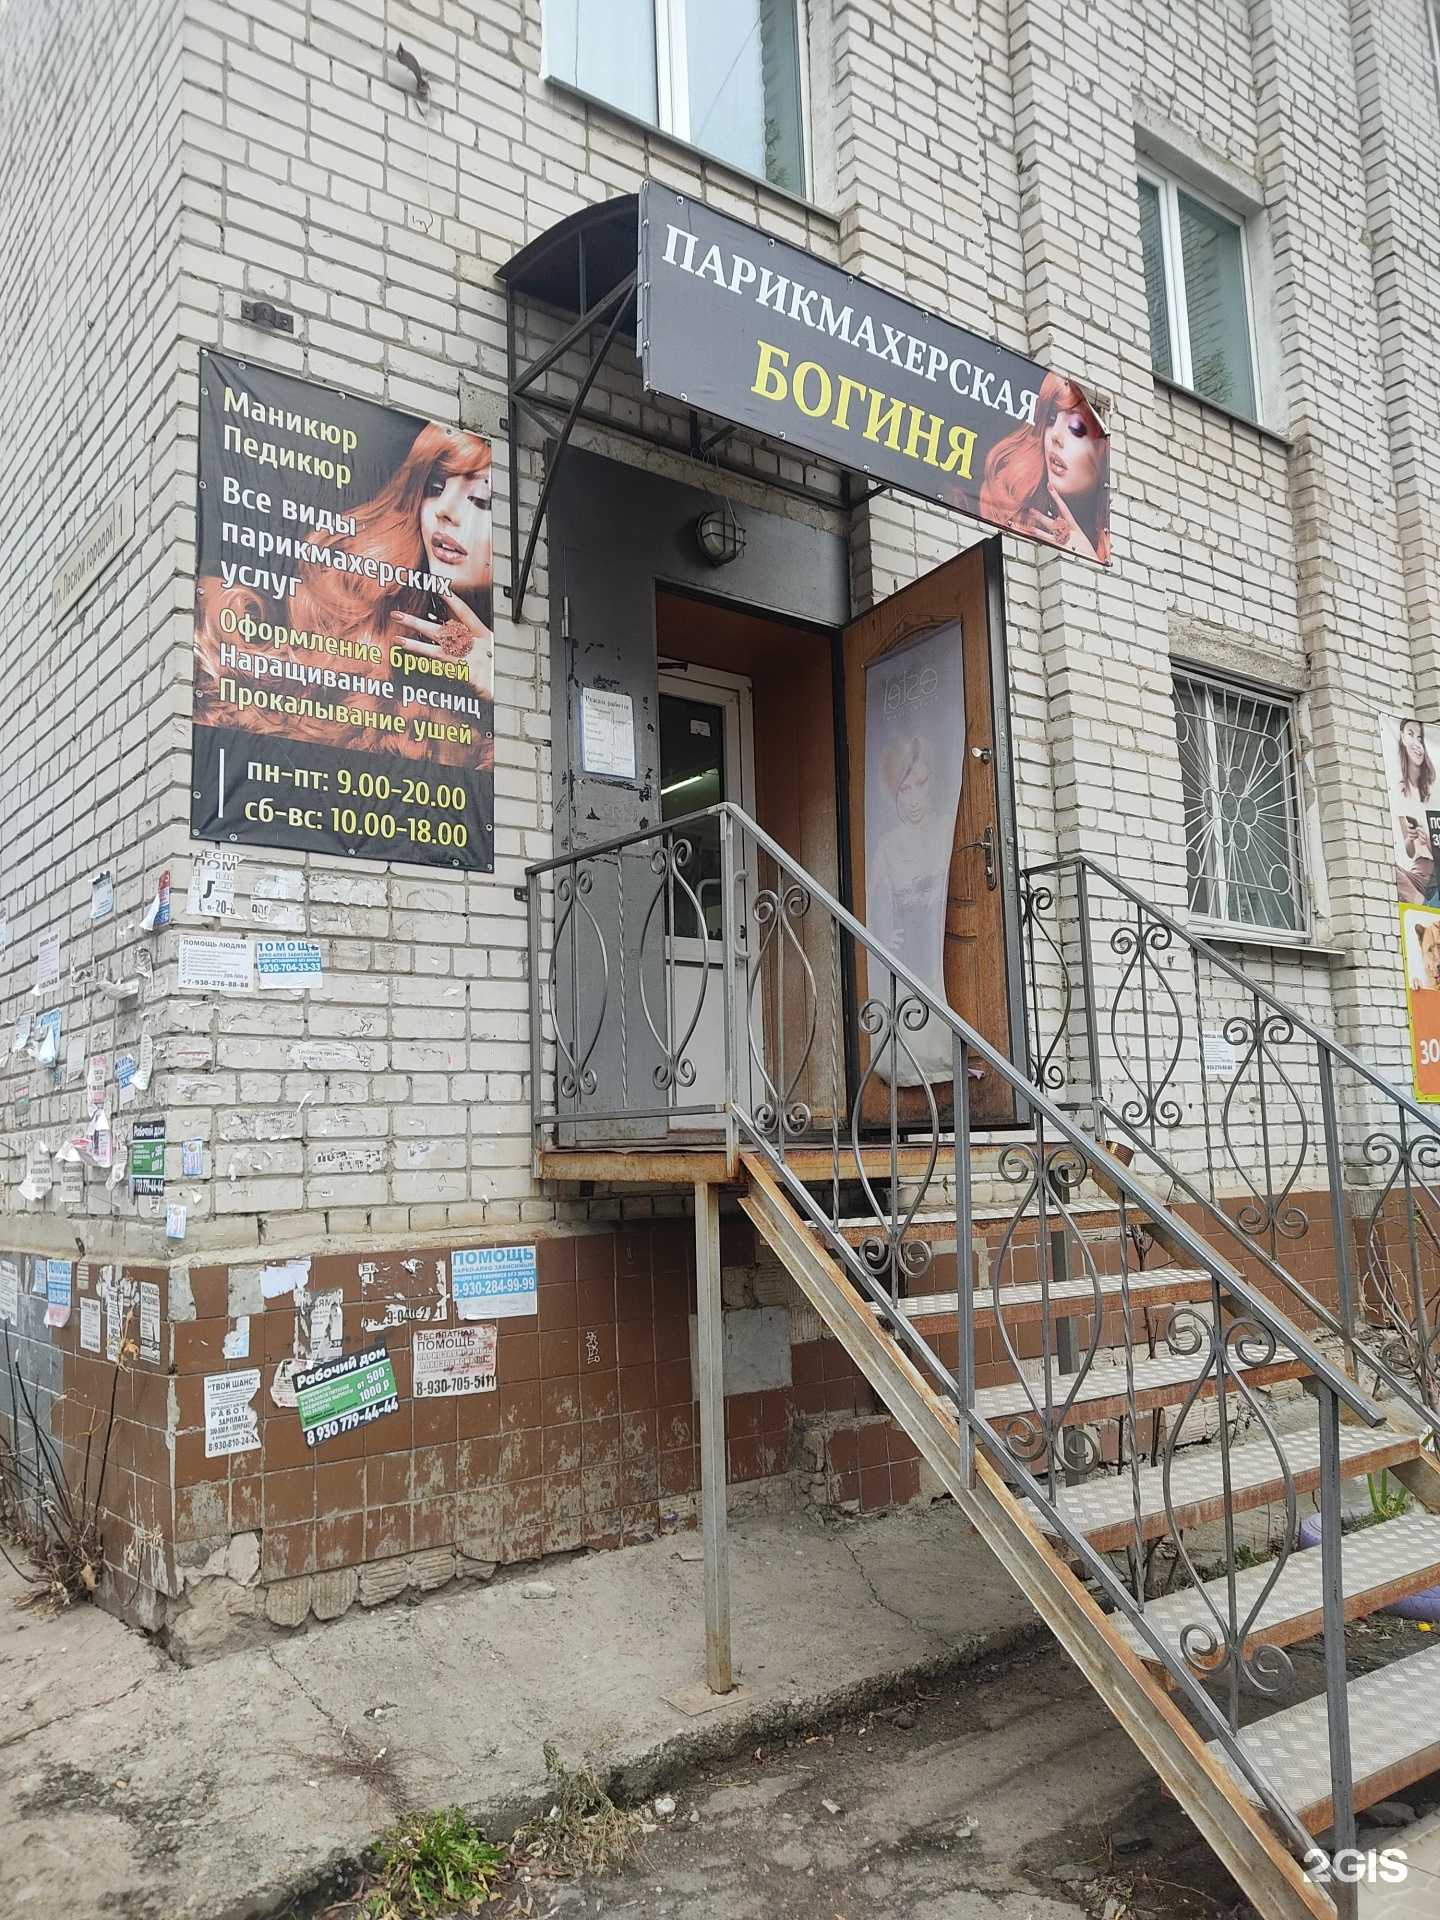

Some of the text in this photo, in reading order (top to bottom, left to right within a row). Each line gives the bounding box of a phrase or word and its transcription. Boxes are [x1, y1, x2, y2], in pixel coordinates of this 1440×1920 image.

[662, 224, 1039, 426] ПАРИКМАХЕРСКАЯ
[223, 386, 358, 454] Маникюр
[750, 340, 978, 480] БОГИНЯ
[223, 424, 352, 488] Педикюр
[222, 476, 357, 537] Все виды
[220, 560, 303, 600] услуг
[221, 521, 453, 598] парикмахерских
[219, 608, 470, 682] Оформление бровей
[219, 642, 481, 719] Наращивание ресниц
[219, 678, 472, 745] Прокалывание ушей
[247, 761, 466, 810] пн-пт: 9.00-20.00
[244, 798, 468, 848] сб-вс: 10.00-18.00
[453, 1247, 534, 1266] ПОМОЩЬ
[453, 1277, 535, 1297] 8-930-284-99-99
[417, 1329, 475, 1341] БЕСПЛАТНАЯ
[417, 1337, 475, 1351] ПОМОЩЬ
[297, 1356, 357, 1389] Рабочий
[359, 1348, 386, 1367] дом
[360, 1382, 381, 1402] 1000
[367, 1367, 385, 1384] 500
[307, 1430, 315, 1446] 8
[316, 1421, 338, 1441] 930
[340, 1397, 399, 1432] 779-44-44
